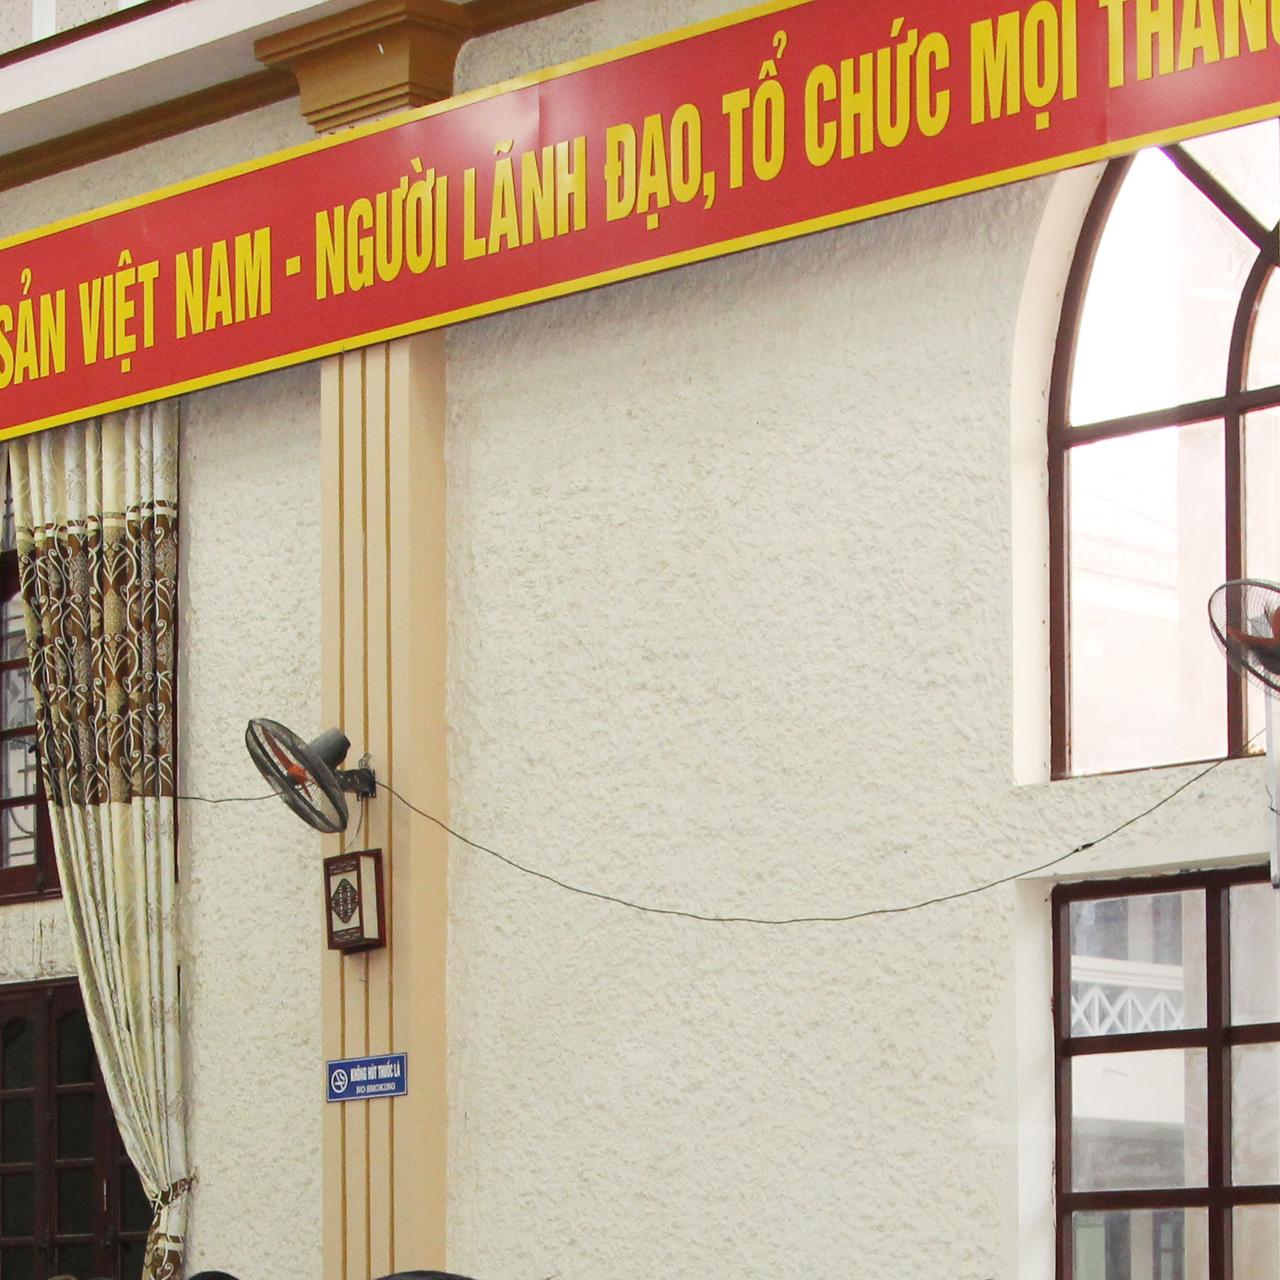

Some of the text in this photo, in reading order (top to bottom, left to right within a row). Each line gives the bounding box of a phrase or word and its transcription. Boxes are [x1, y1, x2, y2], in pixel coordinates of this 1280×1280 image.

[78, 251, 155, 372] VIỆT
[175, 227, 272, 337] NAM
[316, 157, 448, 300] NGƯỜI
[462, 139, 588, 261] LÃNH
[604, 103, 714, 230] ĐẠO,
[722, 30, 787, 193] TỔ
[803, 33, 950, 168] CHỨC
[970, 0, 1078, 130] MỌI
